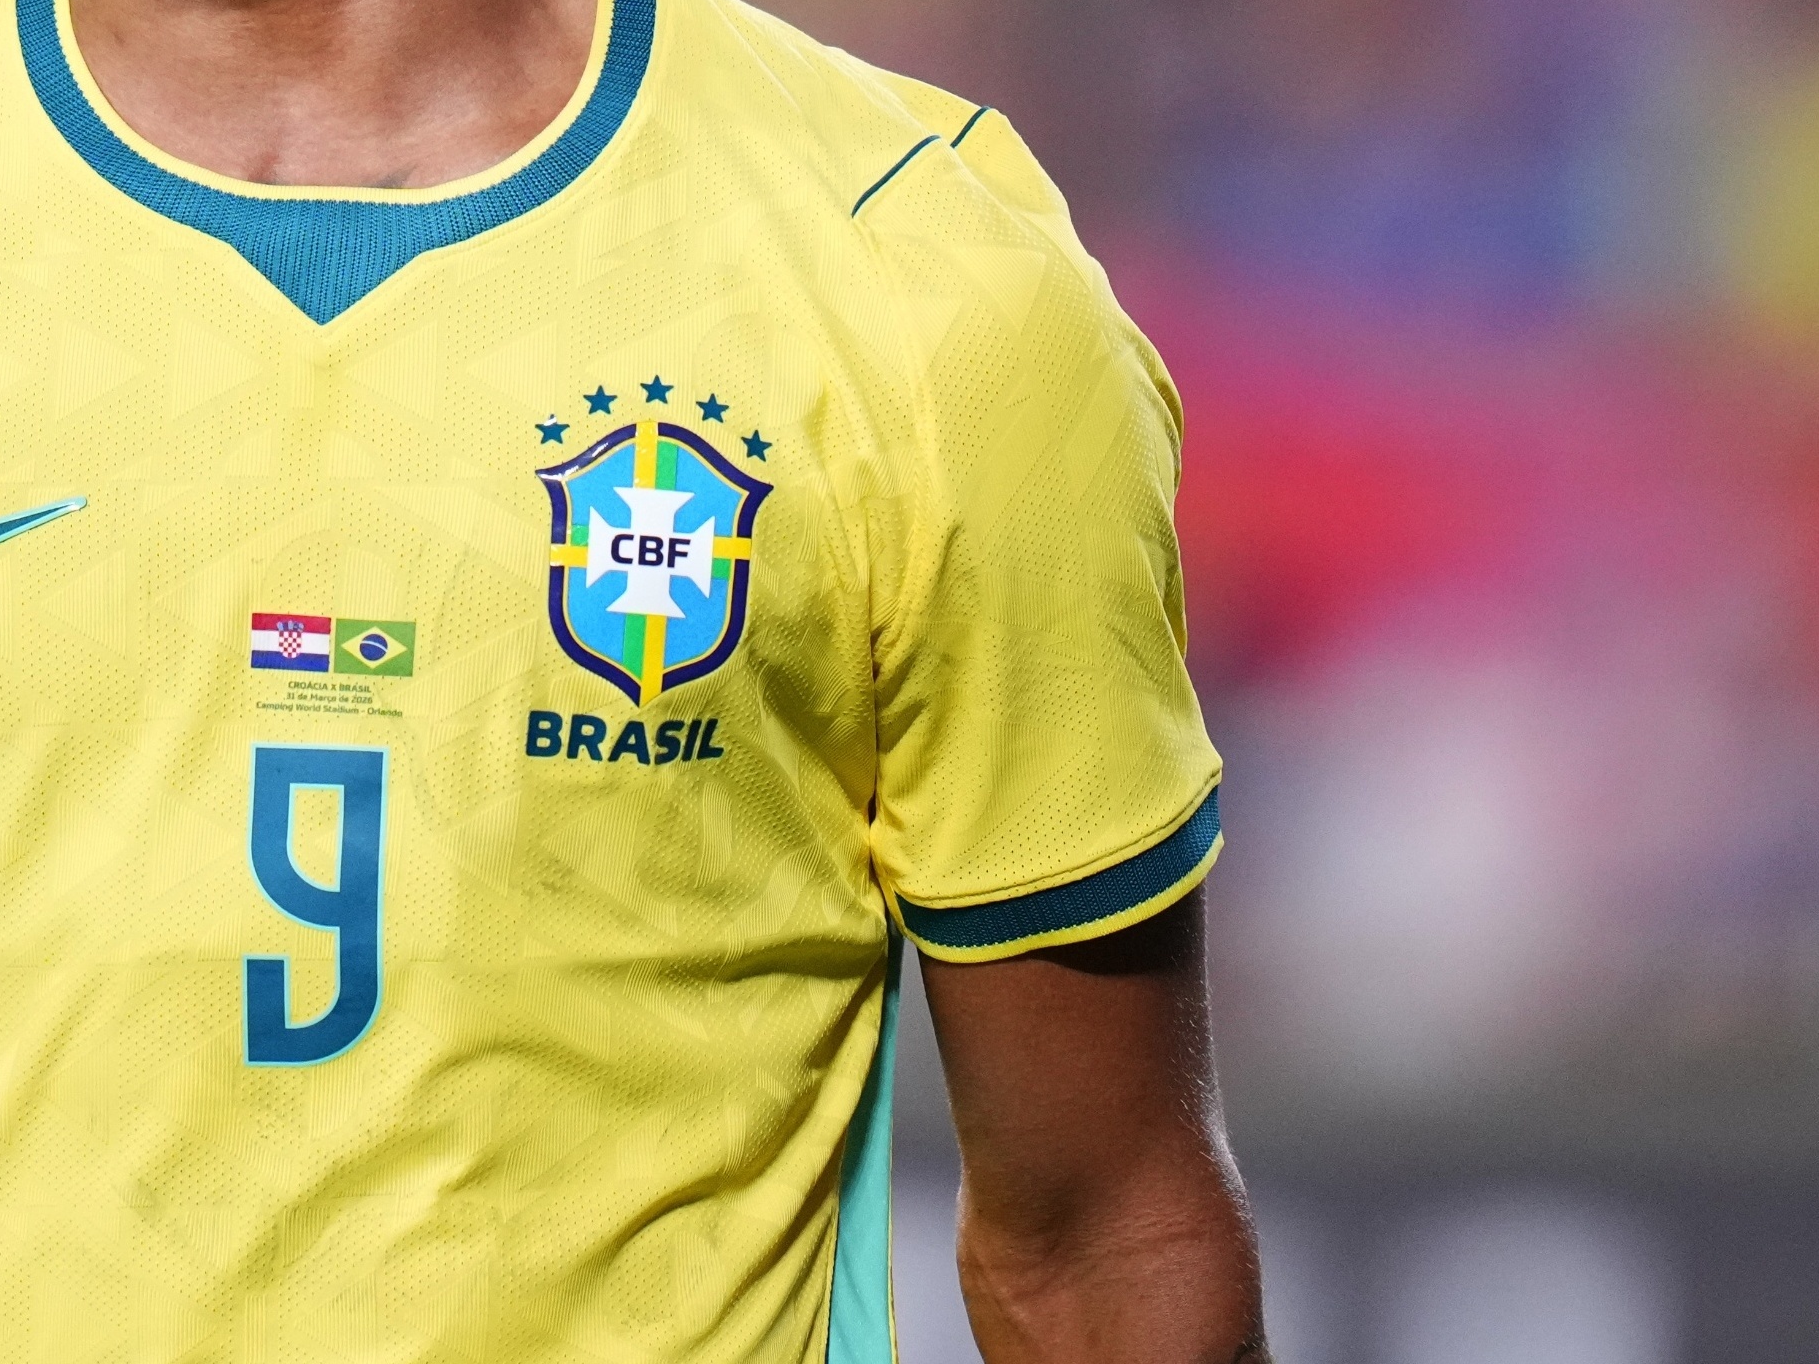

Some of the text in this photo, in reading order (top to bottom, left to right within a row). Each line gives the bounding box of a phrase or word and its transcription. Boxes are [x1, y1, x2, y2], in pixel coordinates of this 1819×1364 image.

[610, 533, 692, 568] CBF
[287, 692, 294, 700] 31
[338, 695, 349, 703] de
[351, 696, 373, 704] 2026
[339, 683, 371, 693] BRASIL
[256, 701, 294, 712] Camping
[296, 703, 321, 712] World
[323, 704, 359, 714] Stadium
[367, 707, 403, 717] Orlando
[525, 709, 726, 766] BRASIL
[242, 741, 390, 1068] 9
